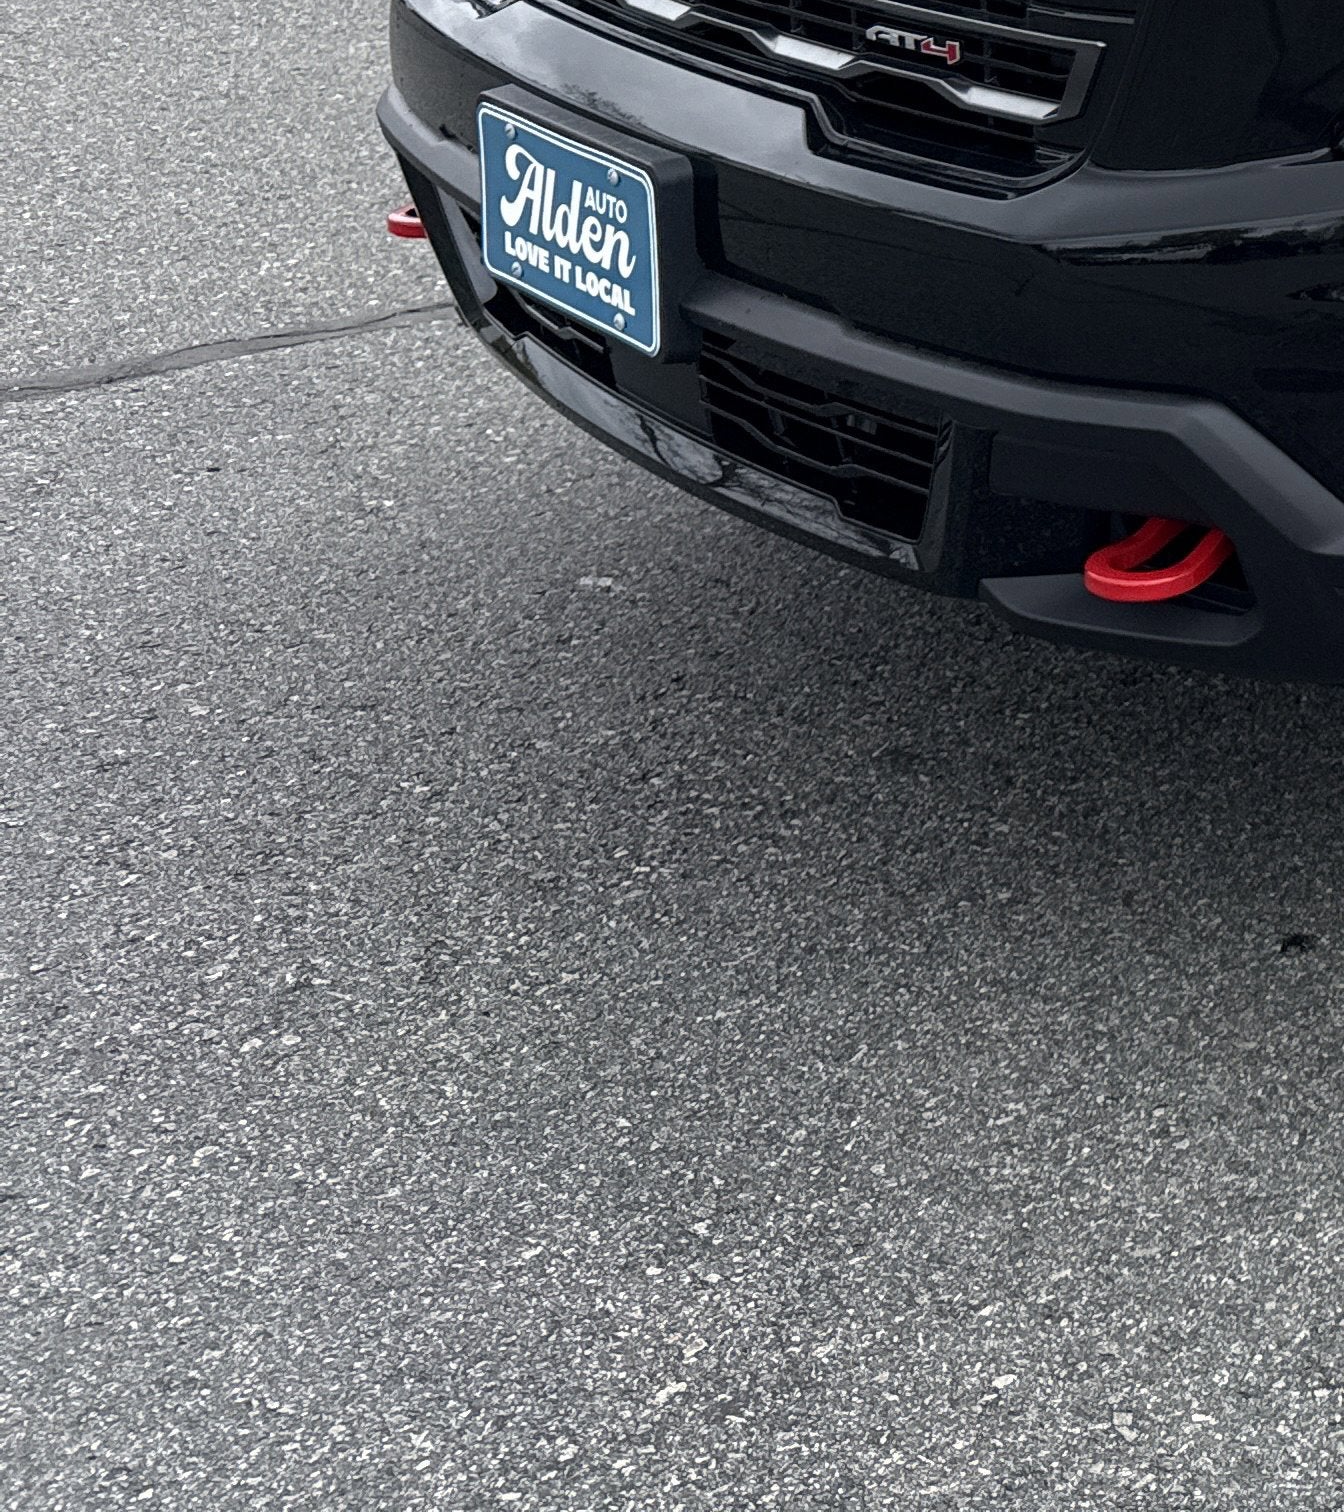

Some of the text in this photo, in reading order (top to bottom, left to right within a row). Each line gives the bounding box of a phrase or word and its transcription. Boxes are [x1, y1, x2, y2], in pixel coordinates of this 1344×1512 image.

[865, 25, 960, 65] AT4
[500, 143, 637, 279] Alden
[584, 186, 628, 224] AUTO
[504, 231, 636, 316] LOVE IT LOCAL
